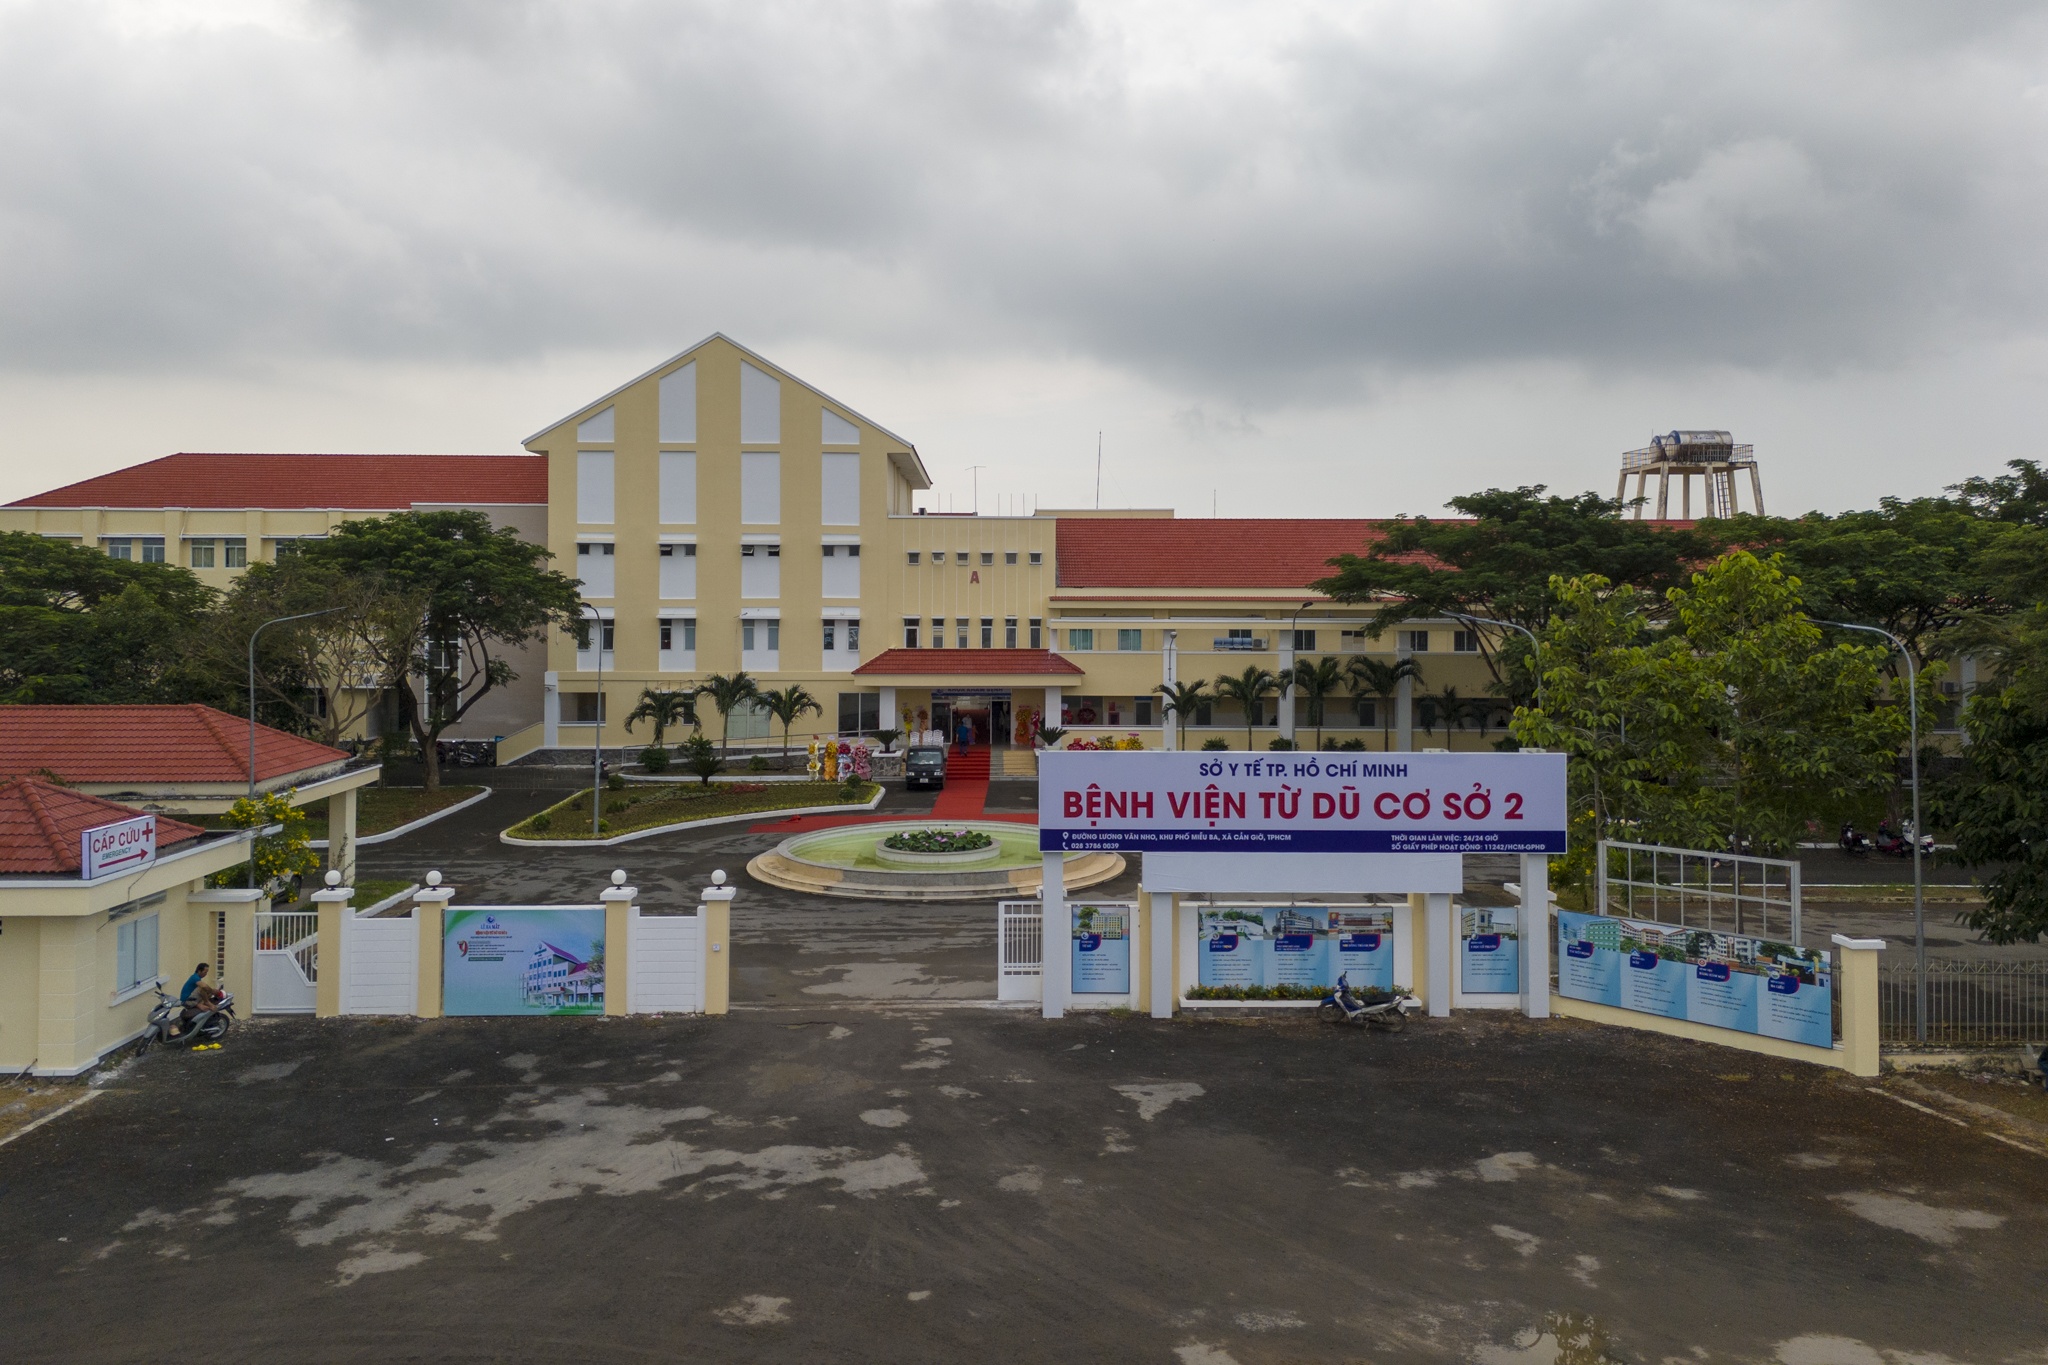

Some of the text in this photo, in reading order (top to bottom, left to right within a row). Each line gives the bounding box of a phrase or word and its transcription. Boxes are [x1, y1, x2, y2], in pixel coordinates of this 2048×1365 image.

[970, 570, 980, 584] A
[1199, 757, 1408, 777] SỞ Y TẾ TP. HỒ CHÍ MINH
[1063, 782, 1524, 827] BỆNH VIỆN TỪ DŨ CƠ SỞ 2
[92, 826, 140, 853] CẤP CỨU
[1071, 832, 1098, 840] ĐƯỜNG
[1140, 833, 1158, 841] NHO,
[1174, 831, 1190, 840] PHỐ
[1208, 833, 1221, 841] BA,
[1221, 832, 1232, 840] XÃ
[1250, 832, 1266, 841] GIỜ,
[1391, 833, 1408, 842] THỜI
[1408, 834, 1427, 842] GIAN
[1428, 833, 1443, 842] LÀM
[1443, 833, 1462, 843] VIỆC:
[1484, 833, 1499, 842] GIỜ
[1391, 841, 1402, 850] SỐ
[1402, 841, 1420, 850] GIẤY
[1420, 842, 1438, 850] PHÉP
[1439, 844, 1459, 852] HOẠT
[1459, 842, 1483, 851] ĐỘNG:
[102, 847, 132, 861] EMERGENCY
